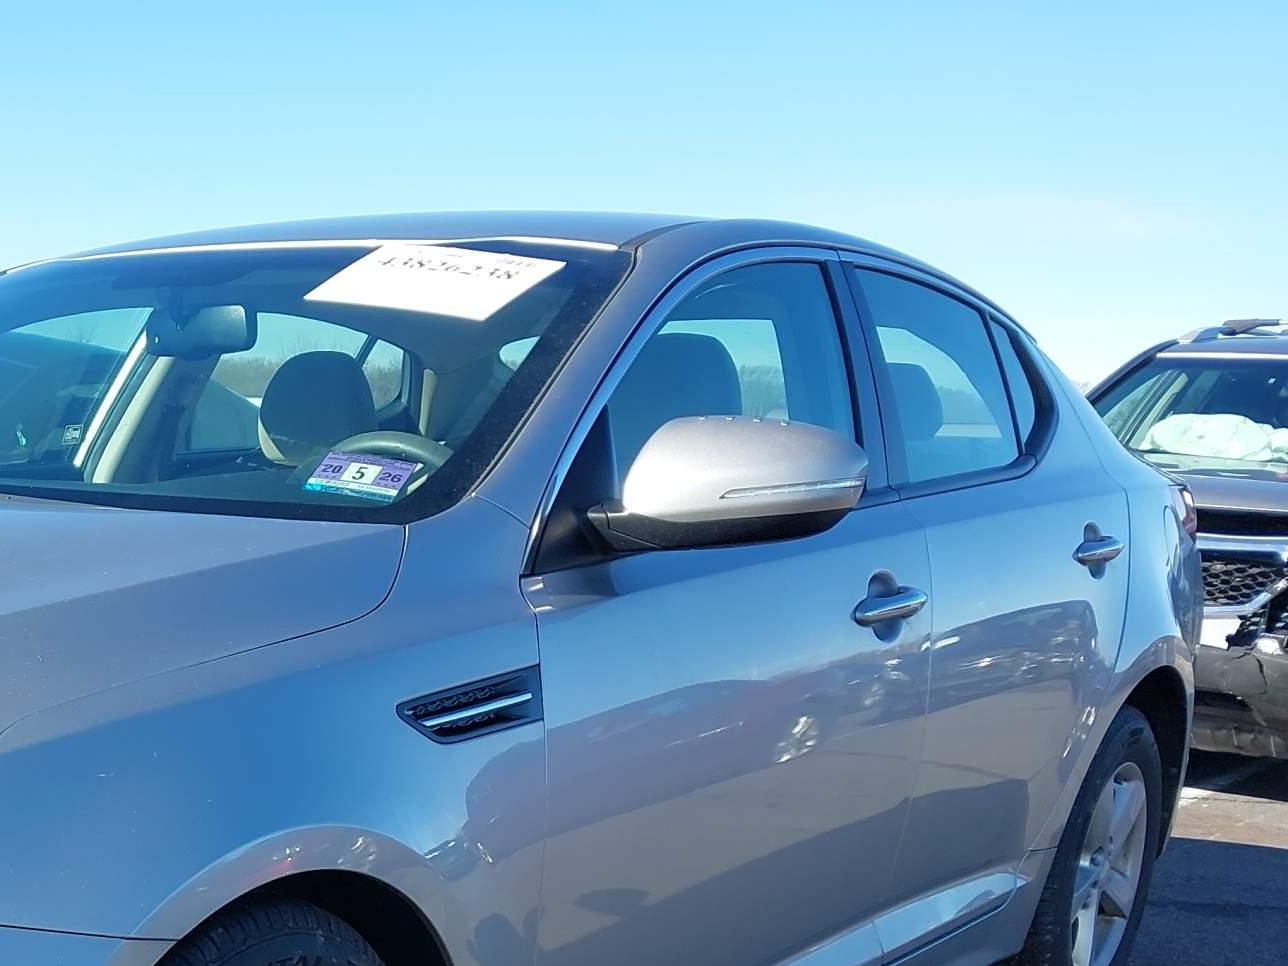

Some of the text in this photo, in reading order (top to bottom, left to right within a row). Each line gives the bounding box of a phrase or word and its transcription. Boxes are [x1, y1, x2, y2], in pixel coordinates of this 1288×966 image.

[321, 463, 404, 483] 20 5 26
